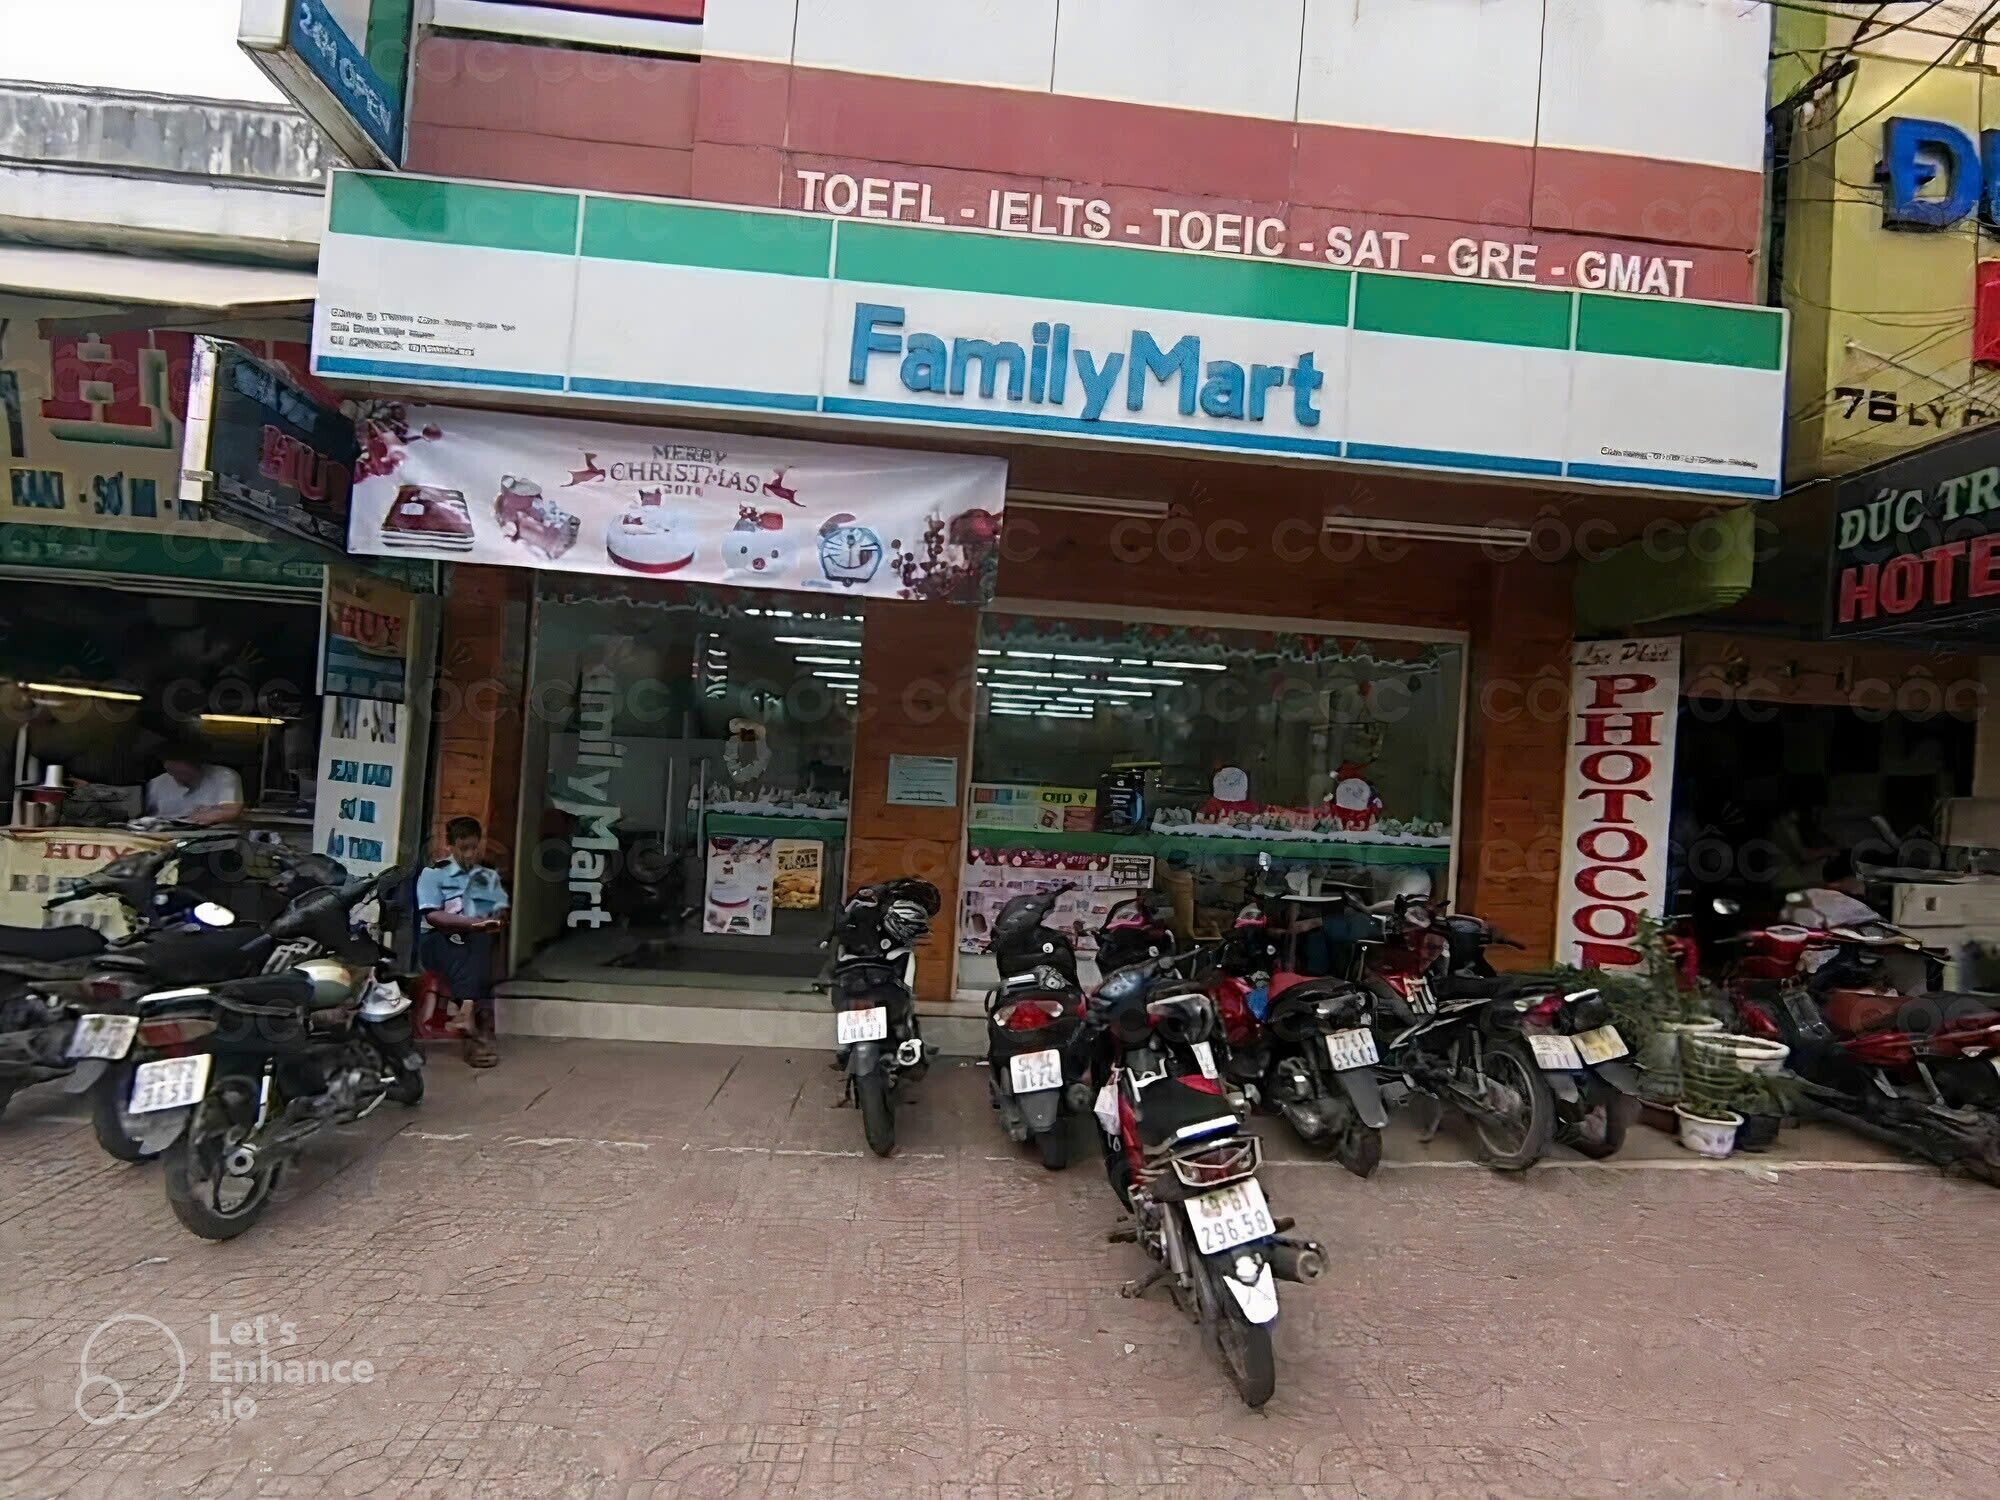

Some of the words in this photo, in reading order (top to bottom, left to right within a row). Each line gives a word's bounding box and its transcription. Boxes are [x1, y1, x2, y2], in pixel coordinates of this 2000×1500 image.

[797, 170, 946, 225] TOEFL
[987, 189, 1112, 240] IELTS
[1154, 208, 1287, 257] TOEIC
[1325, 226, 1409, 269] SAT
[1447, 238, 1539, 283] GRE
[1575, 250, 1694, 298] GMAT
[848, 302, 1325, 428] FamilyMart
[610, 461, 760, 494] CHRISTMAS
[652, 444, 728, 466] MERRY
